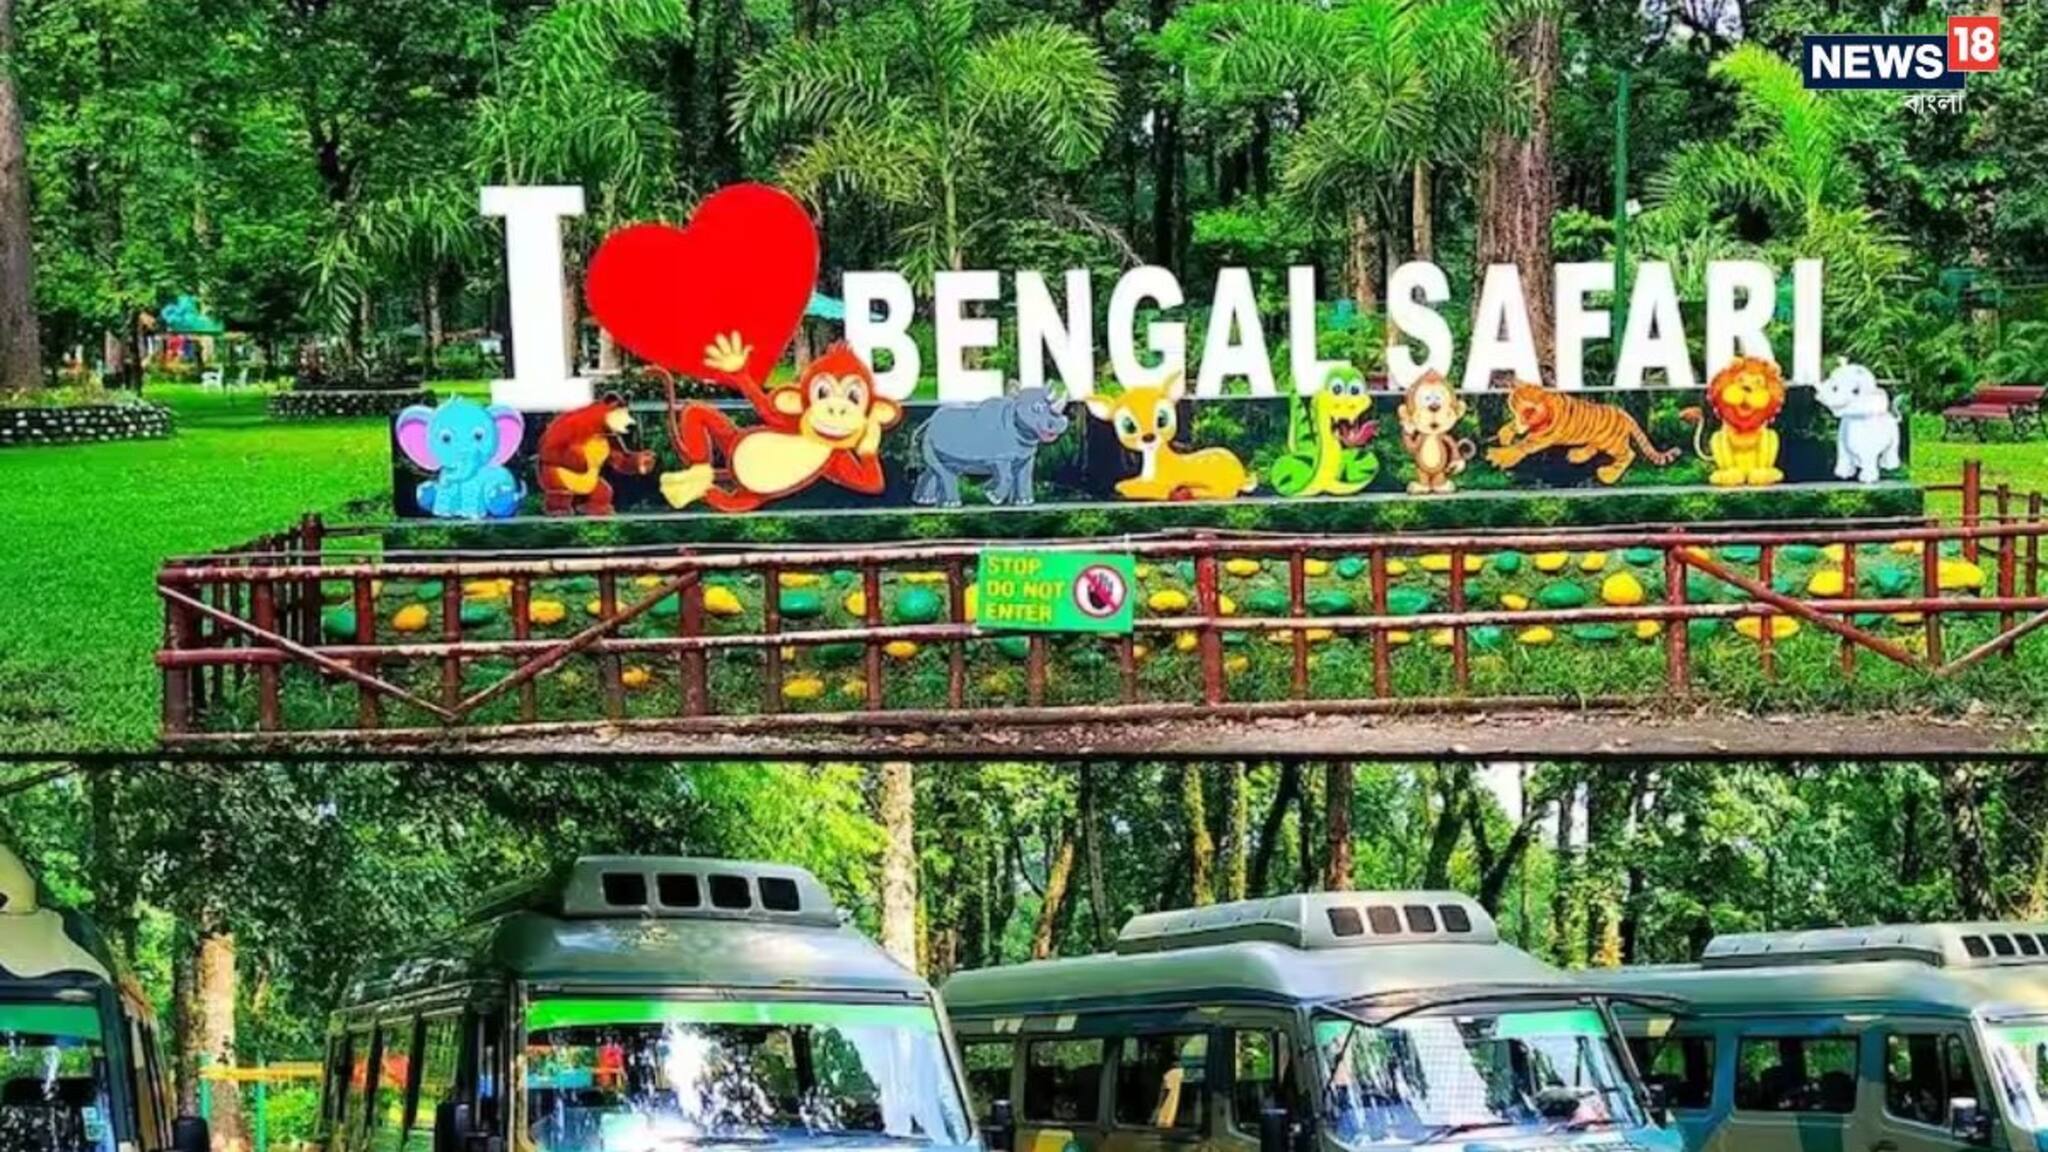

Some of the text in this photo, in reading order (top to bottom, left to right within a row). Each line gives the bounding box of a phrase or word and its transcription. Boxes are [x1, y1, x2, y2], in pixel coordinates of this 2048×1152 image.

[480, 185, 1824, 411] I BENGAL SAFARI
[986, 556, 1042, 574] STOP
[986, 580, 1065, 599] DO NOT
[985, 603, 1051, 622] ENTER
